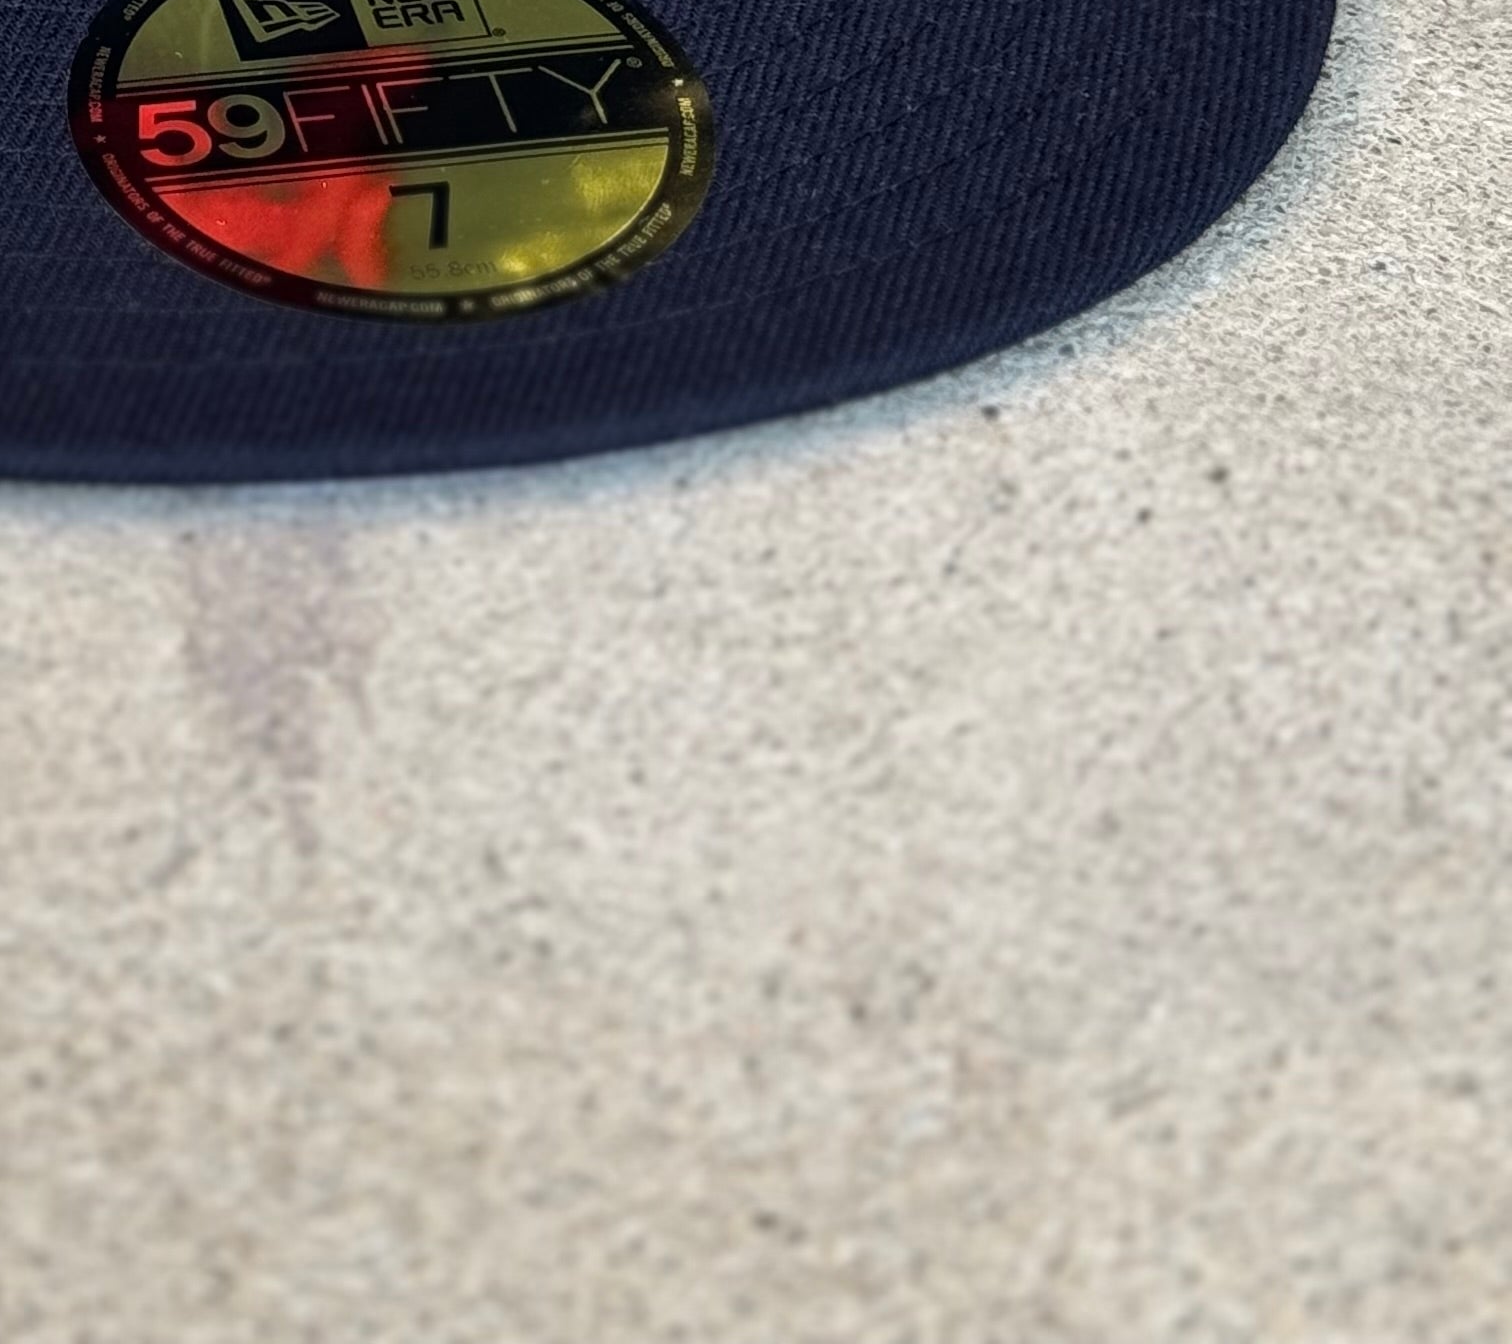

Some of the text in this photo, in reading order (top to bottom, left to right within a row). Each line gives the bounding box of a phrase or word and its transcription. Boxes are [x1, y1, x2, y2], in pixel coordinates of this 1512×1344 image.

[373, 1, 465, 29] ERA
[146, 211, 164, 224] OF
[162, 222, 186, 242] THE
[186, 239, 217, 262] TRUE
[390, 181, 450, 249] 7
[577, 265, 594, 282] OF
[594, 254, 621, 271] THE
[616, 234, 647, 257] TRUE
